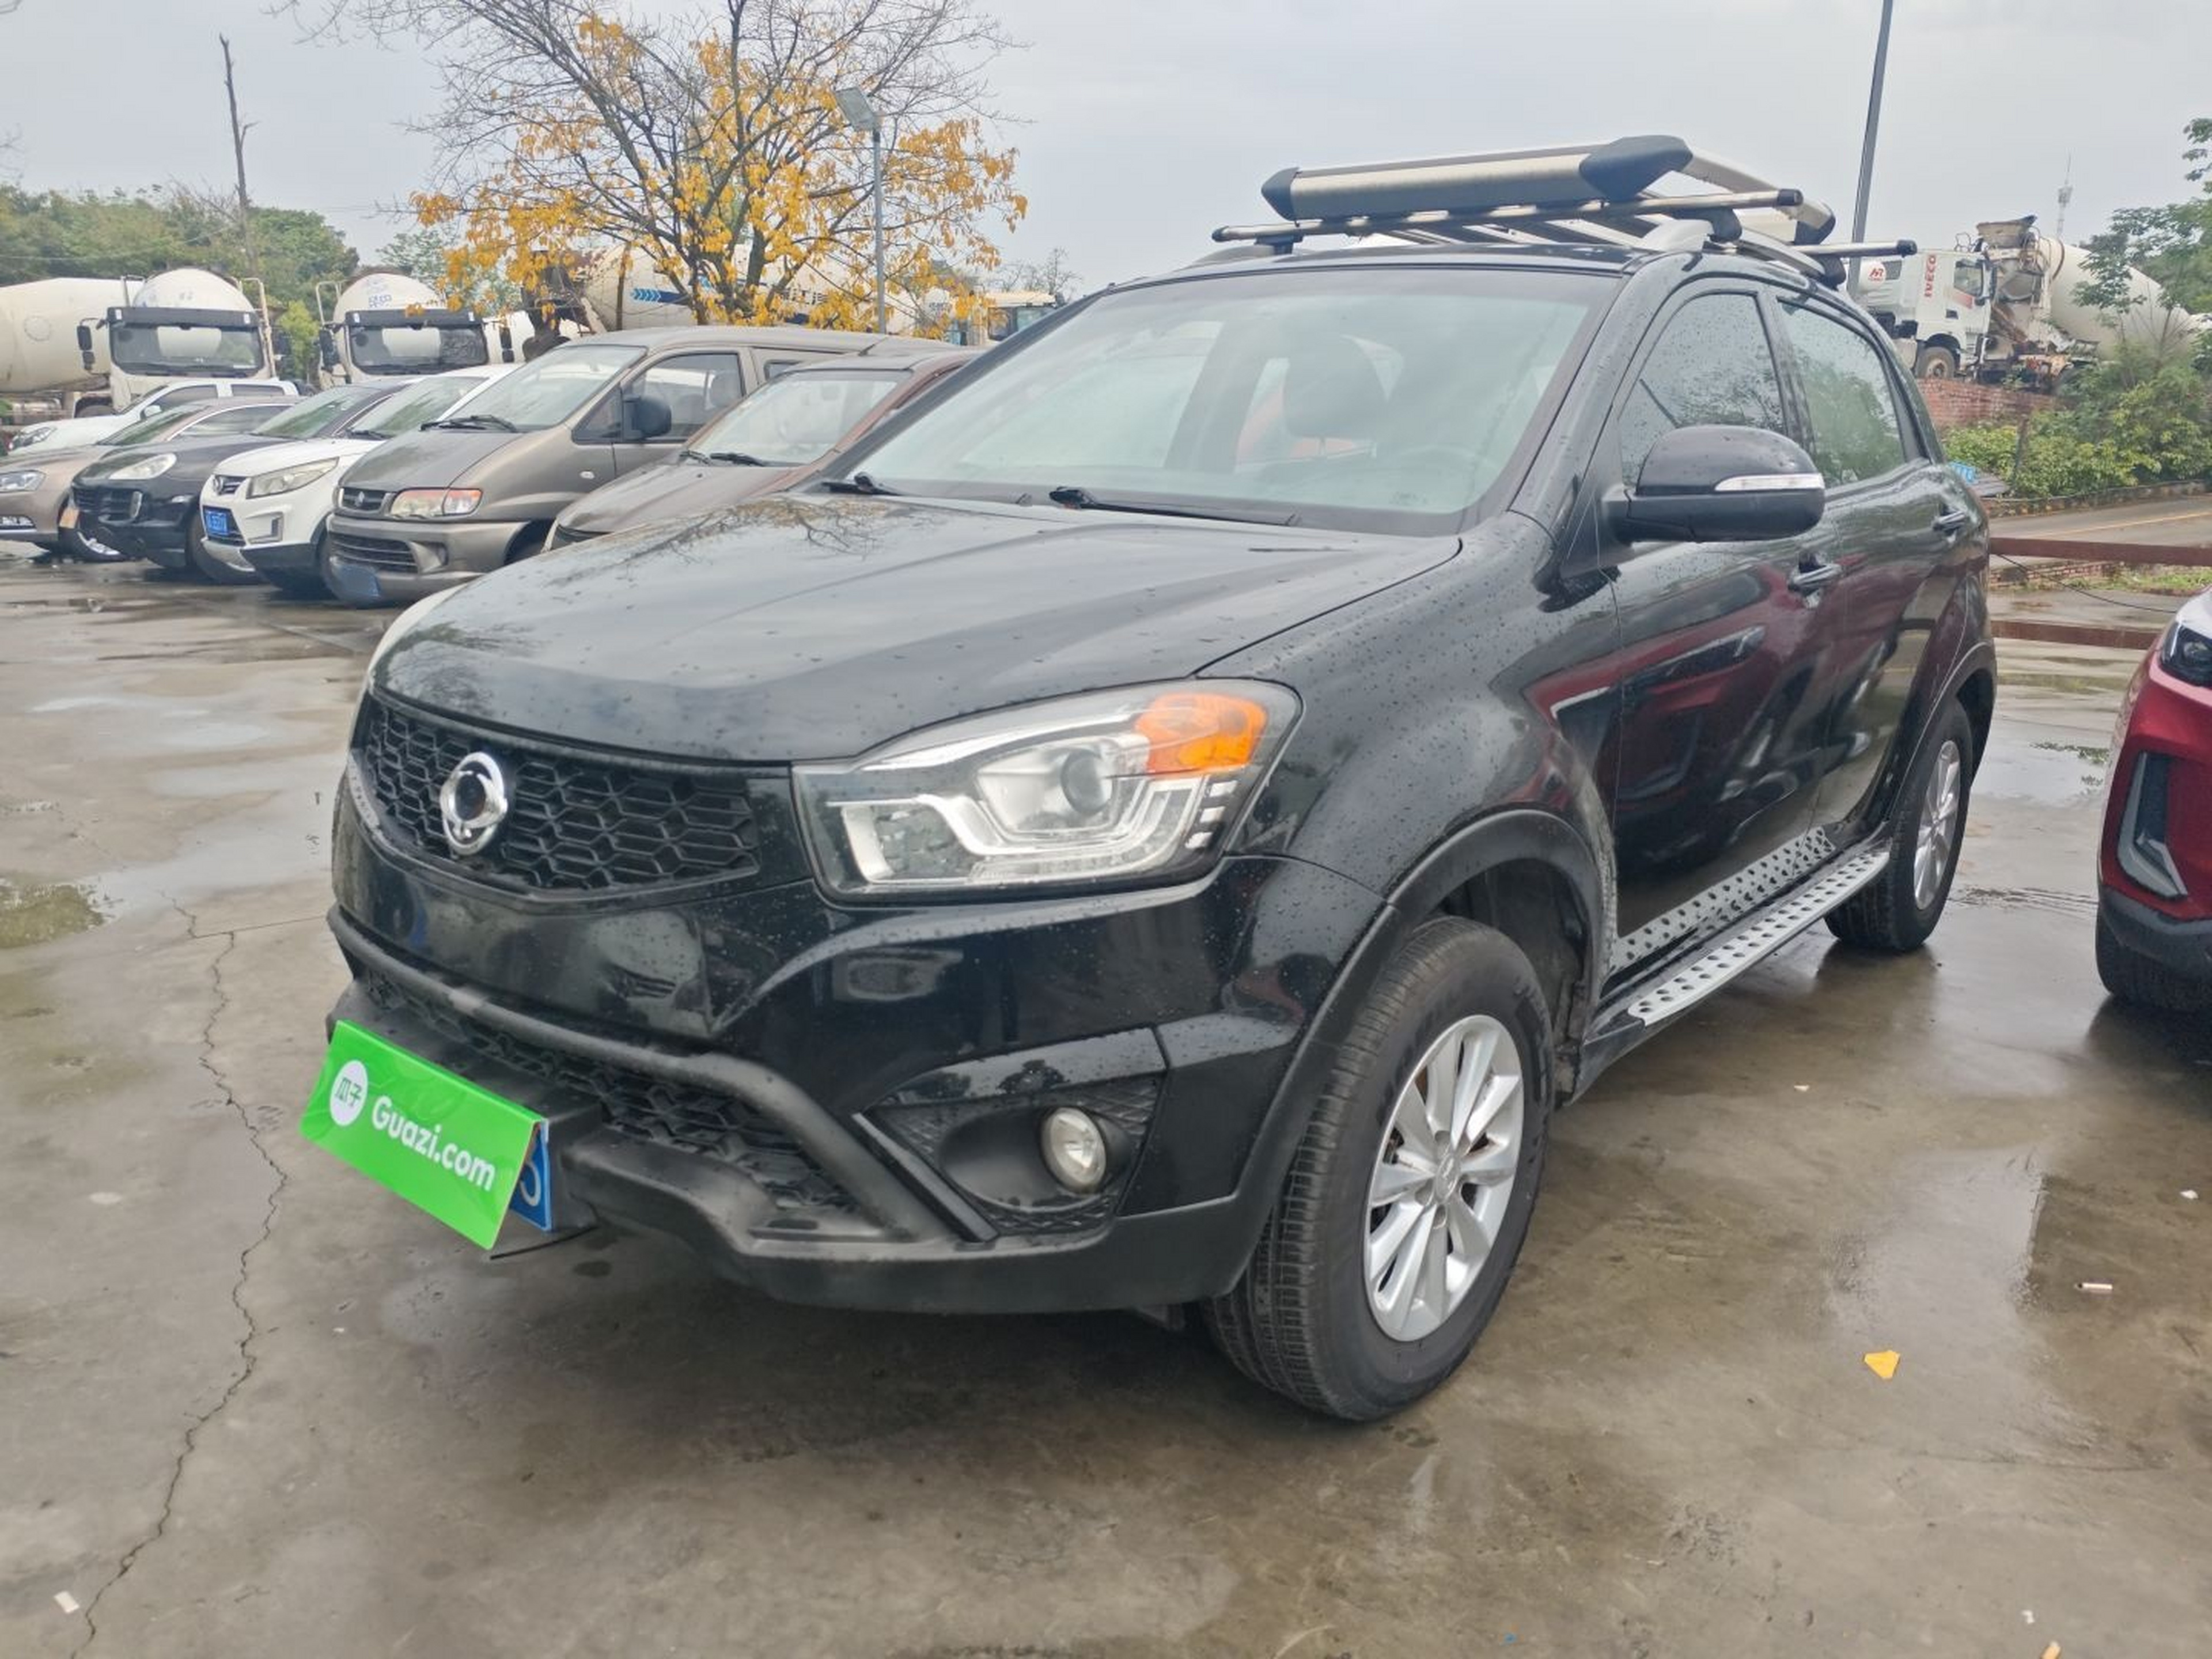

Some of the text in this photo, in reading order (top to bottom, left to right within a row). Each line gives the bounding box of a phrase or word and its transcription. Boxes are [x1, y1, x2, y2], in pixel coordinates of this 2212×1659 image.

[1924, 255, 1936, 297] IVECO
[336, 1076, 362, 1108] 瓜子
[372, 1094, 496, 1191] Guazi.com
